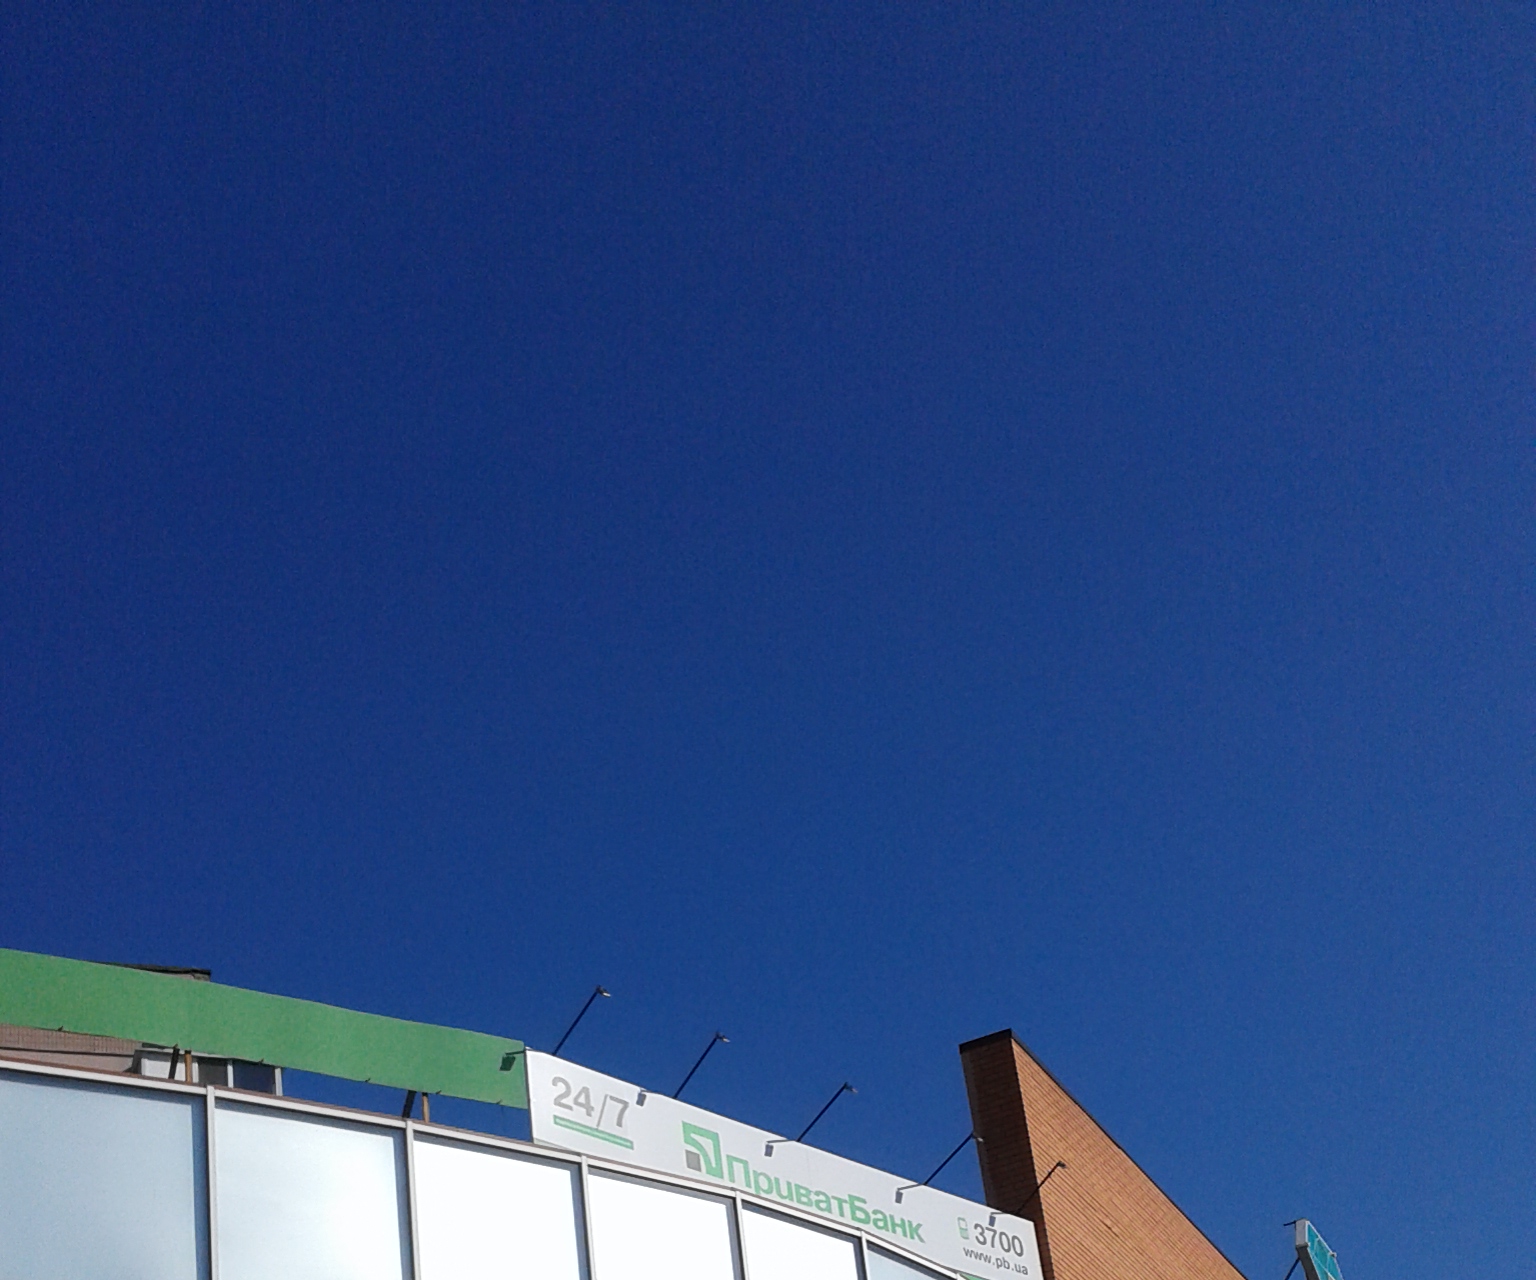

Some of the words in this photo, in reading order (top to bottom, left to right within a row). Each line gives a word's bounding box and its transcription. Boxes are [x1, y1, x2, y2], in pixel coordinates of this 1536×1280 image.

[550, 1076, 630, 1130] 24/7
[725, 1153, 926, 1243] ПриватБанк
[963, 1247, 1029, 1275] www.pb.ua
[974, 1222, 1024, 1257] 3700
